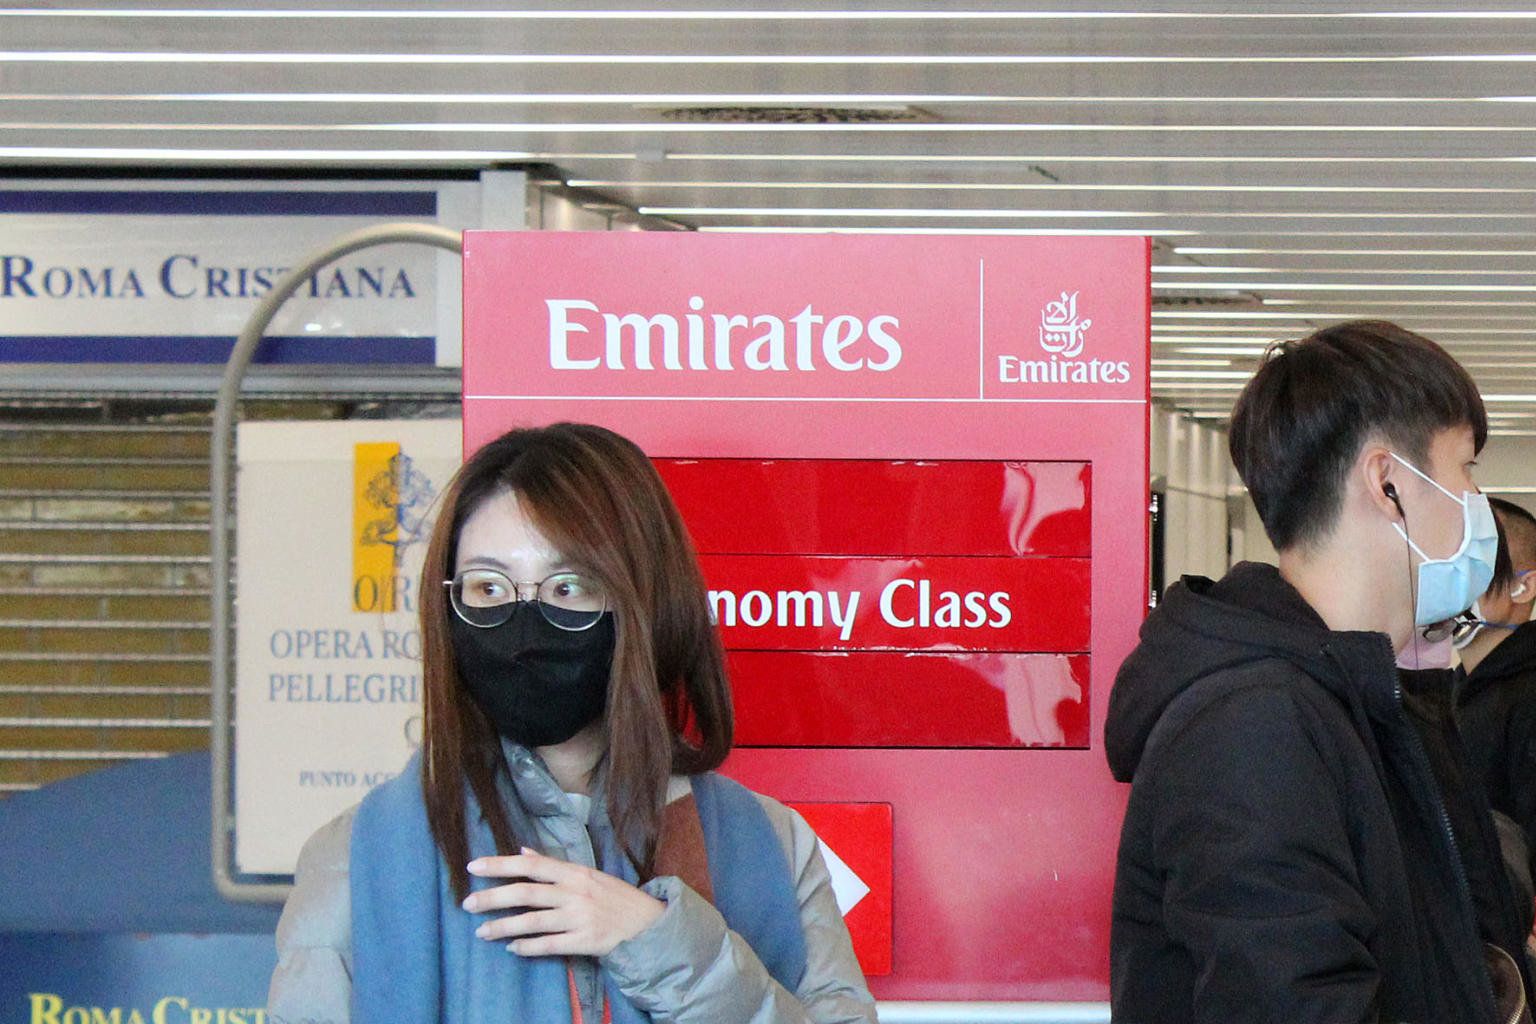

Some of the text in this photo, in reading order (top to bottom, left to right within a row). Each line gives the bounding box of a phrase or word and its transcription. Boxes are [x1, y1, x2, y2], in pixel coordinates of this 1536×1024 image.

[545, 295, 902, 371] Emirates
[998, 354, 1131, 384] Emirates
[354, 574, 419, 613] OR
[707, 578, 1012, 640] nomy Class
[270, 628, 374, 660] OPERA
[268, 673, 420, 704] PELLEGRI
